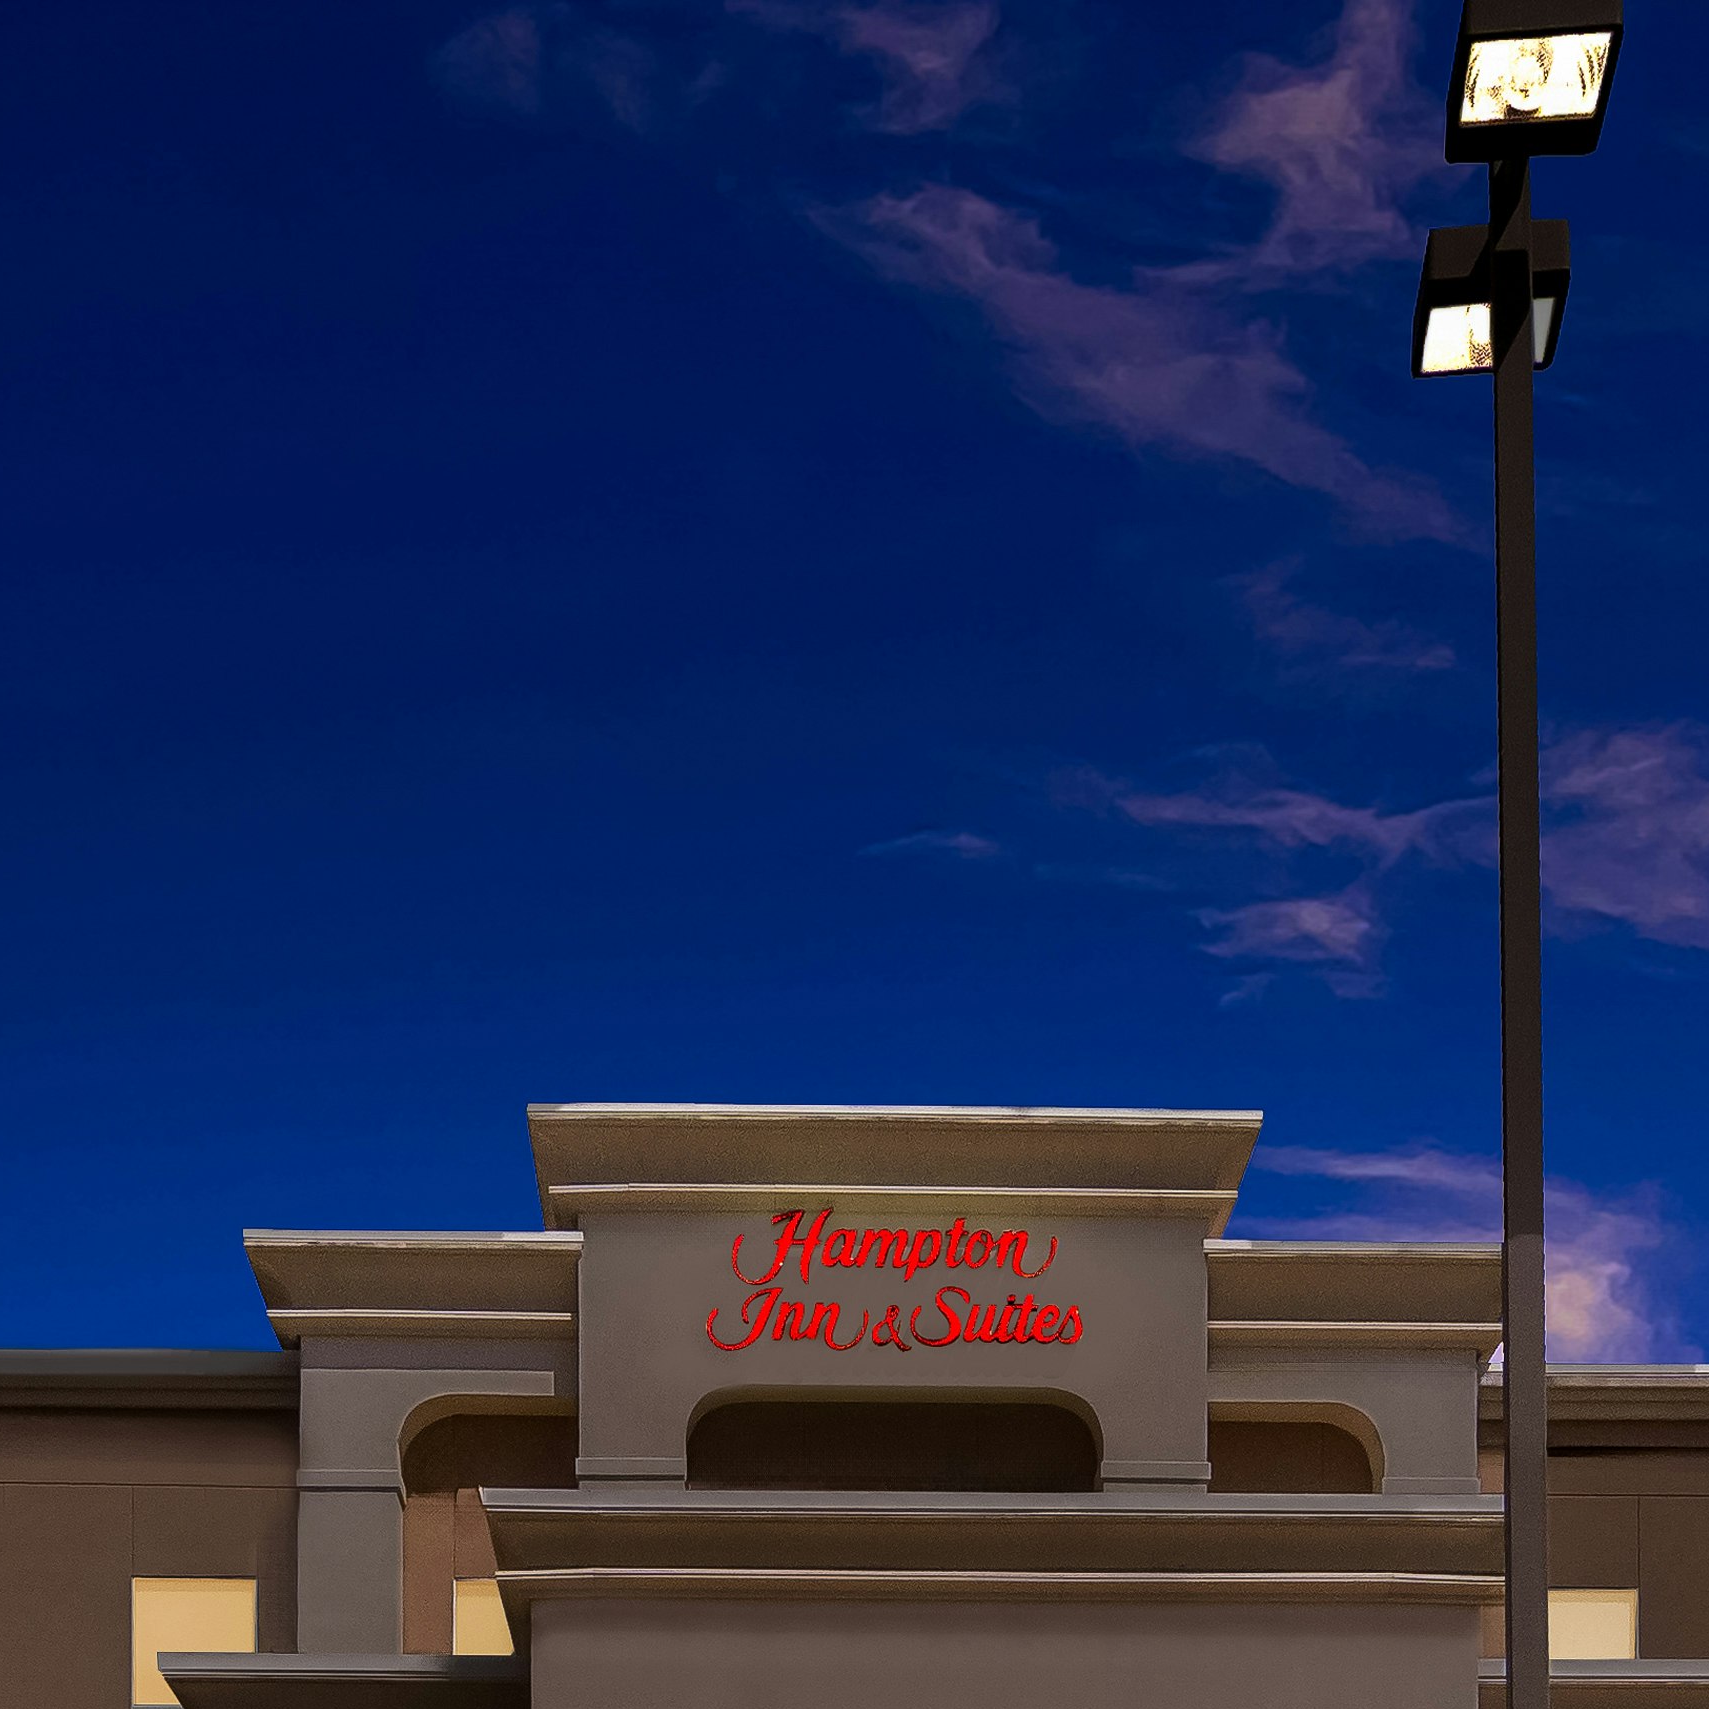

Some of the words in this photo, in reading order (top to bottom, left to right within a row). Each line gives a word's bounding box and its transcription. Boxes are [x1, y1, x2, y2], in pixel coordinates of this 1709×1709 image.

[731, 1207, 1059, 1285] Hampton
[706, 1287, 870, 1351] Inn
[871, 1304, 912, 1352] &
[909, 1286, 1084, 1347] Suites
